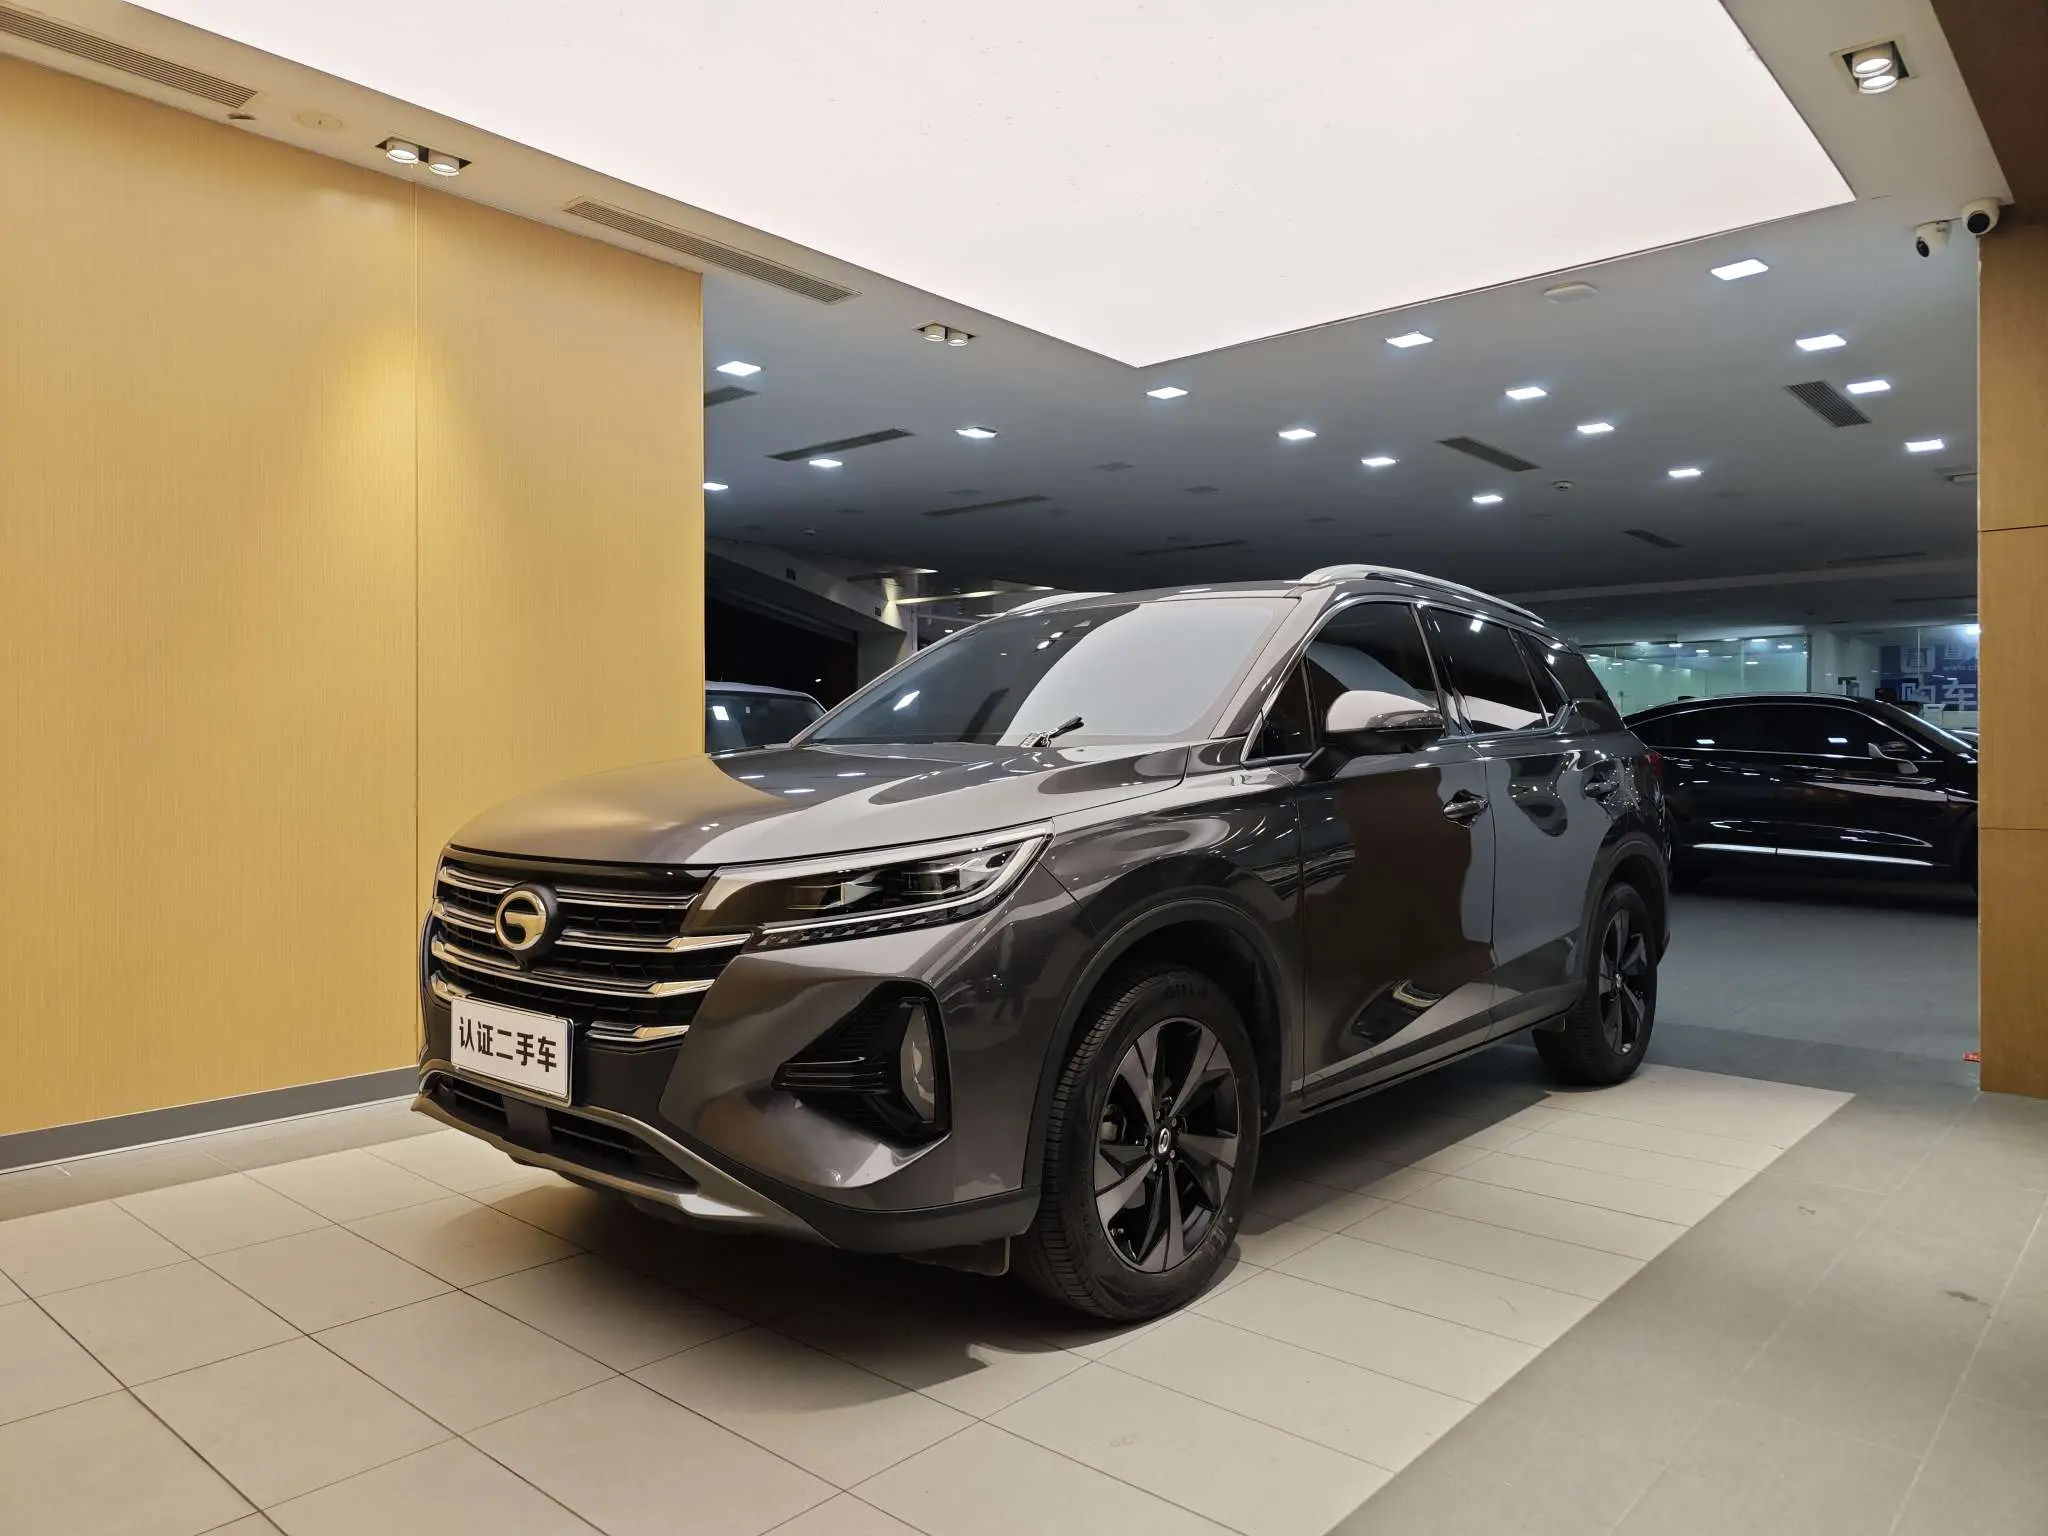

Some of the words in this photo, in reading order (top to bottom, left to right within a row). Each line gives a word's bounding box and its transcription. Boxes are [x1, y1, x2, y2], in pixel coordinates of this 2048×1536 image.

[459, 1016, 557, 1073] 认证二手车
